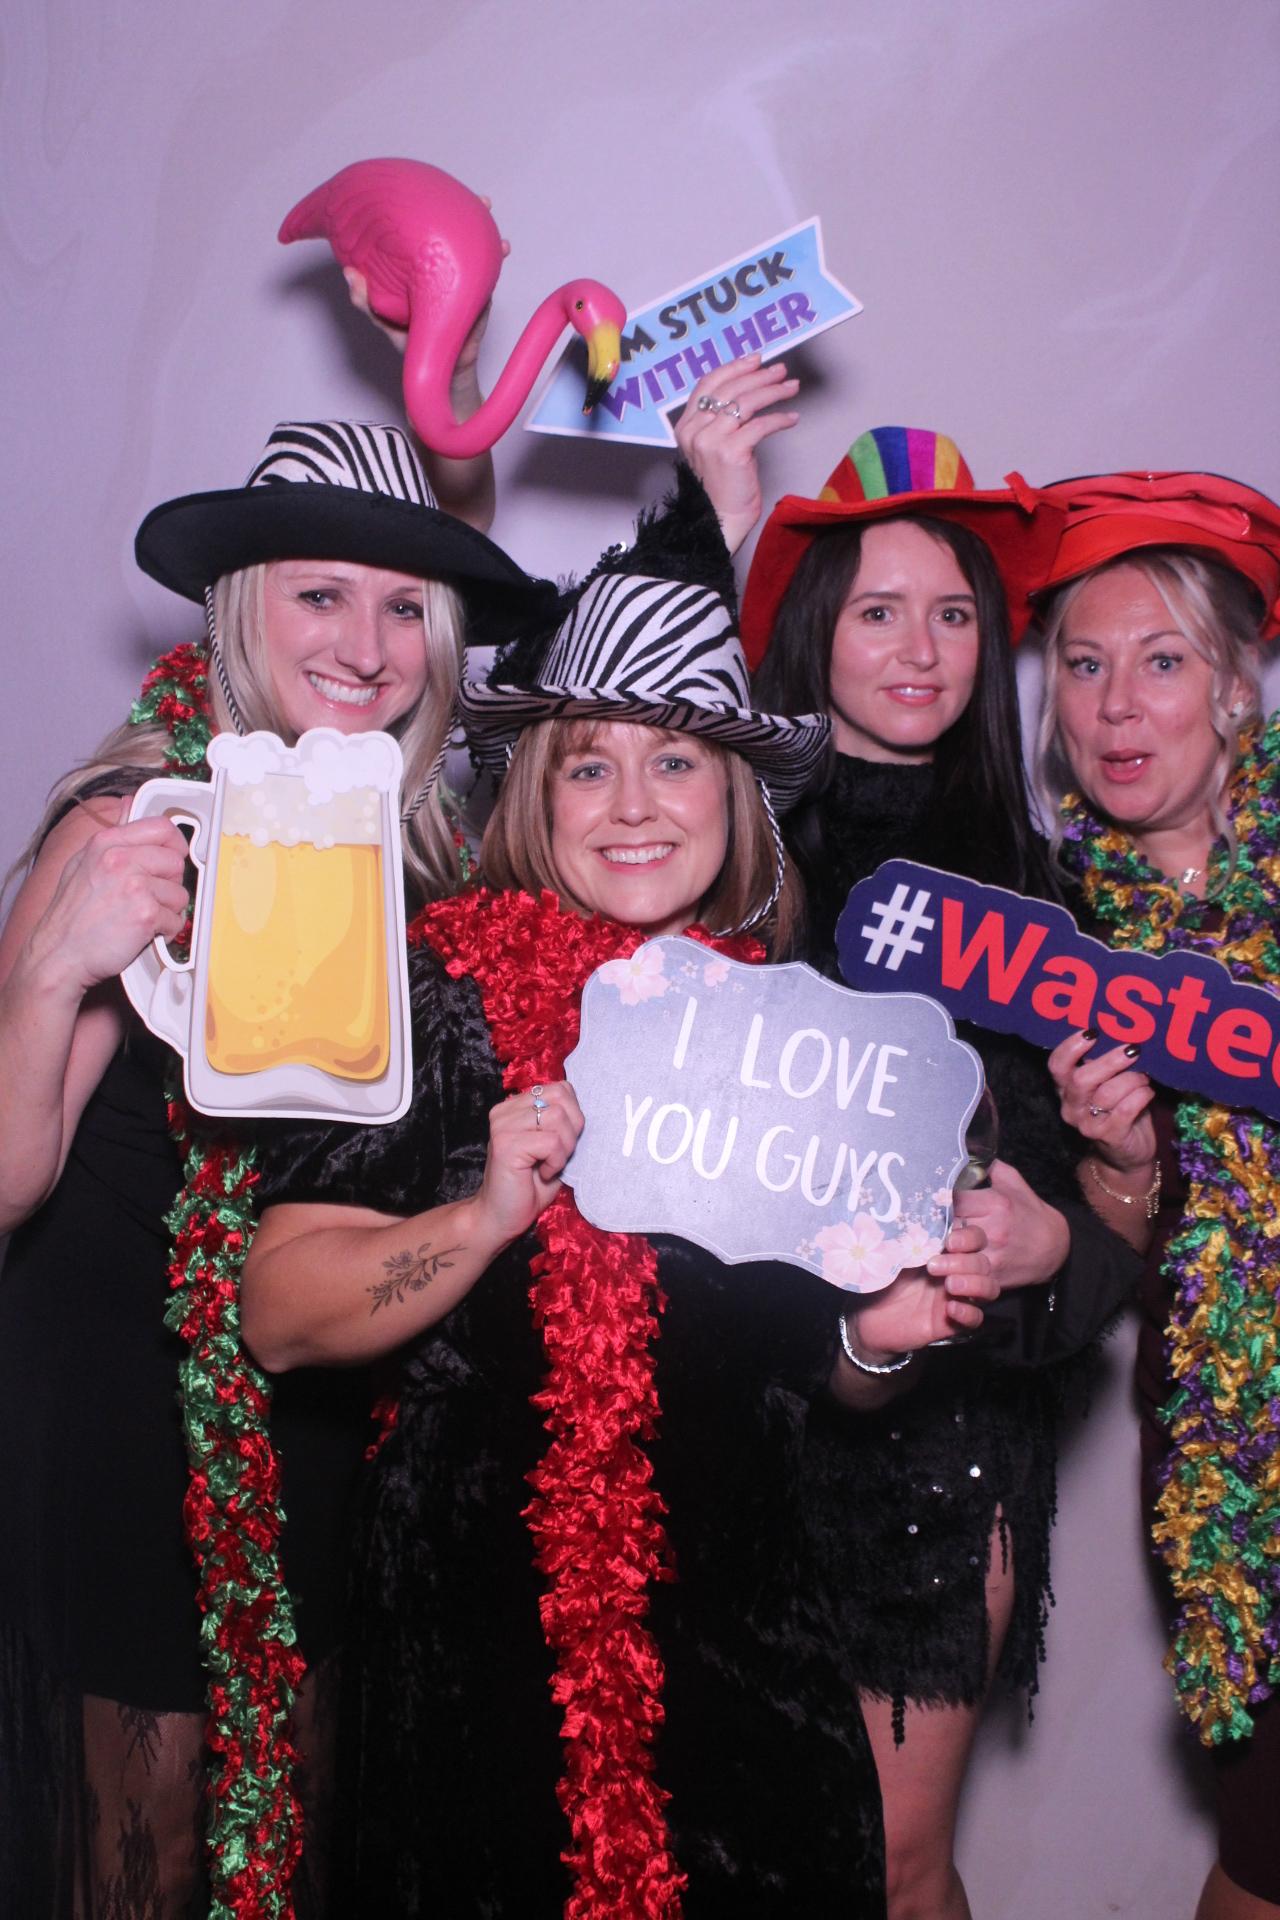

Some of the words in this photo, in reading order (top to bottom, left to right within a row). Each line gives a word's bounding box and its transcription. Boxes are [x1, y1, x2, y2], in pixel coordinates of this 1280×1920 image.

[600, 338, 723, 422] WITH
[722, 292, 816, 356] HER
[659, 251, 794, 340] STUCK
[861, 884, 1280, 1089] #Waste
[673, 997, 698, 1069] I
[740, 1013, 908, 1117] LOVE
[622, 1094, 739, 1180] YOU
[756, 1125, 905, 1223] GUYS
